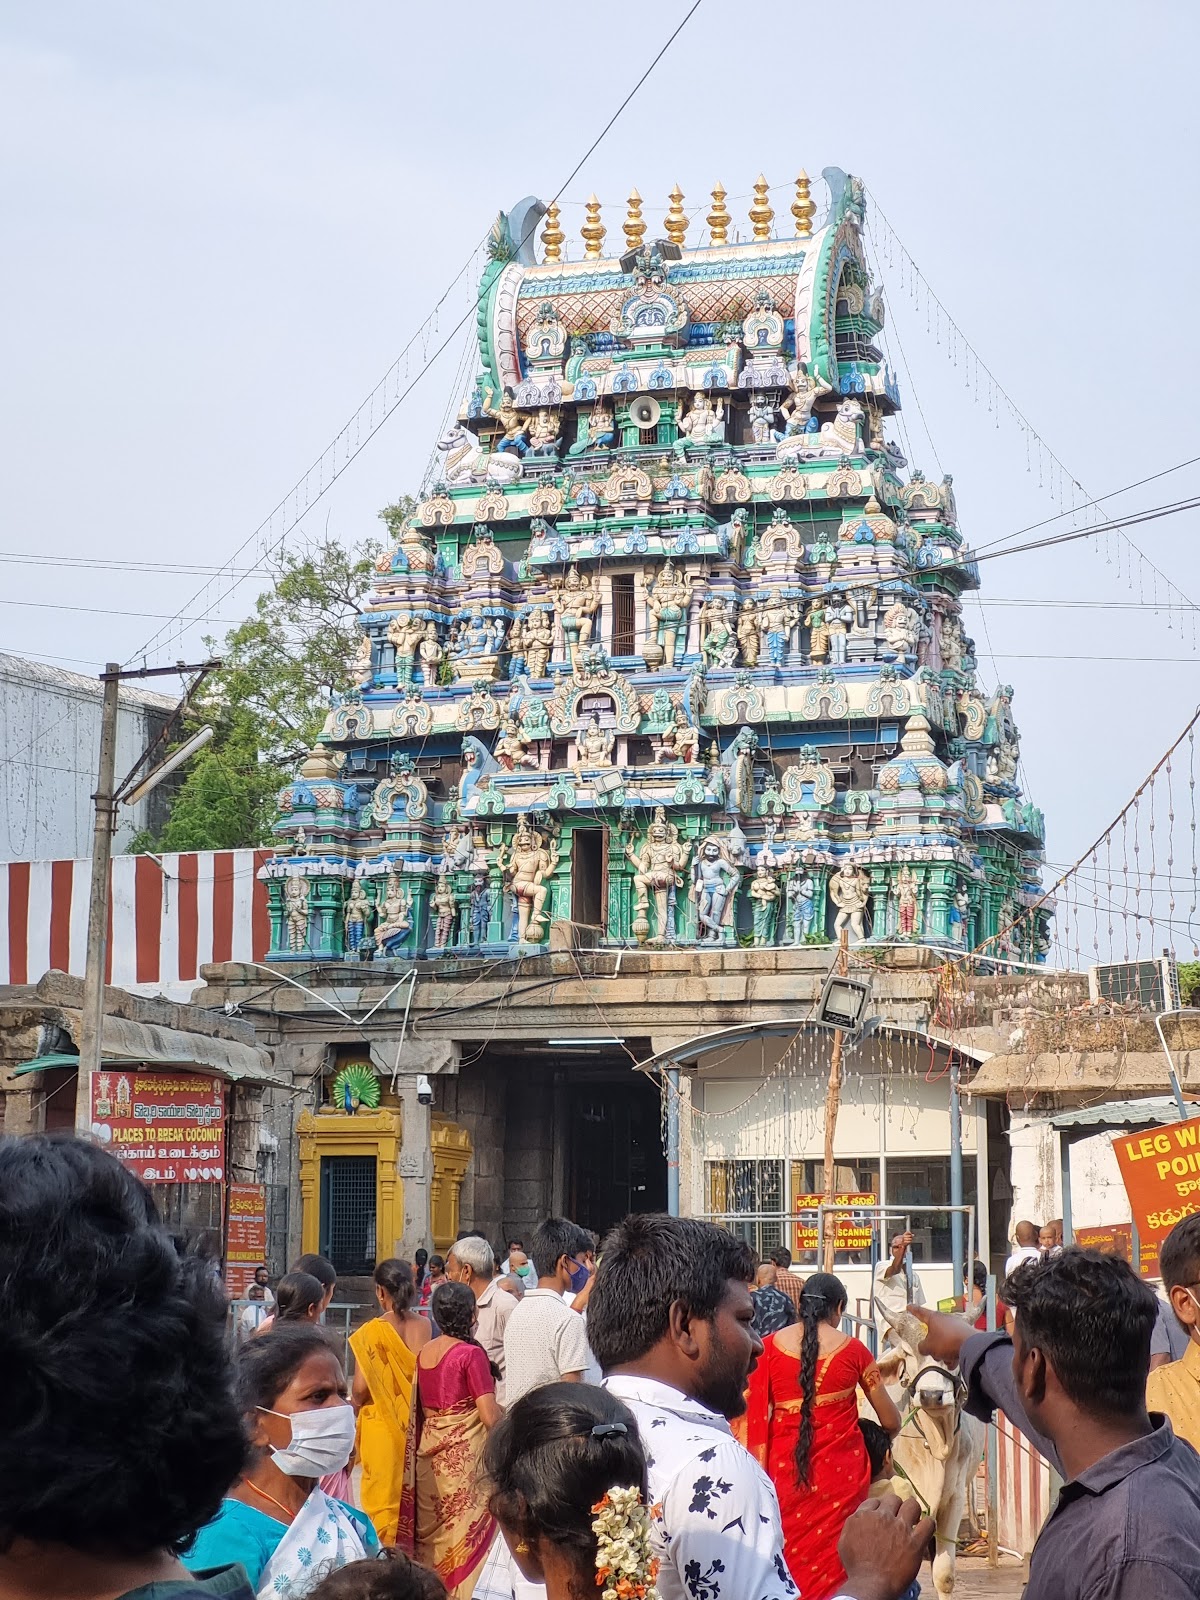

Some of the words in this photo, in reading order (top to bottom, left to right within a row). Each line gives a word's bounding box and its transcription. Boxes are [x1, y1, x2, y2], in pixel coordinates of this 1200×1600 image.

[134, 1103, 157, 1124] కొబ్బరి
[158, 1103, 185, 1119] కాయలు
[113, 1128, 144, 1142] PLACES
[145, 1128, 156, 1142] TO
[158, 1128, 184, 1142] BREAK
[185, 1127, 222, 1142] COCONUT
[1125, 1134, 1172, 1161] LEG
[1174, 1124, 1200, 1148] W
[158, 1145, 221, 1160] உடைக்கும்
[143, 1166, 176, 1180] இடம்
[847, 1239, 872, 1247] POINT
